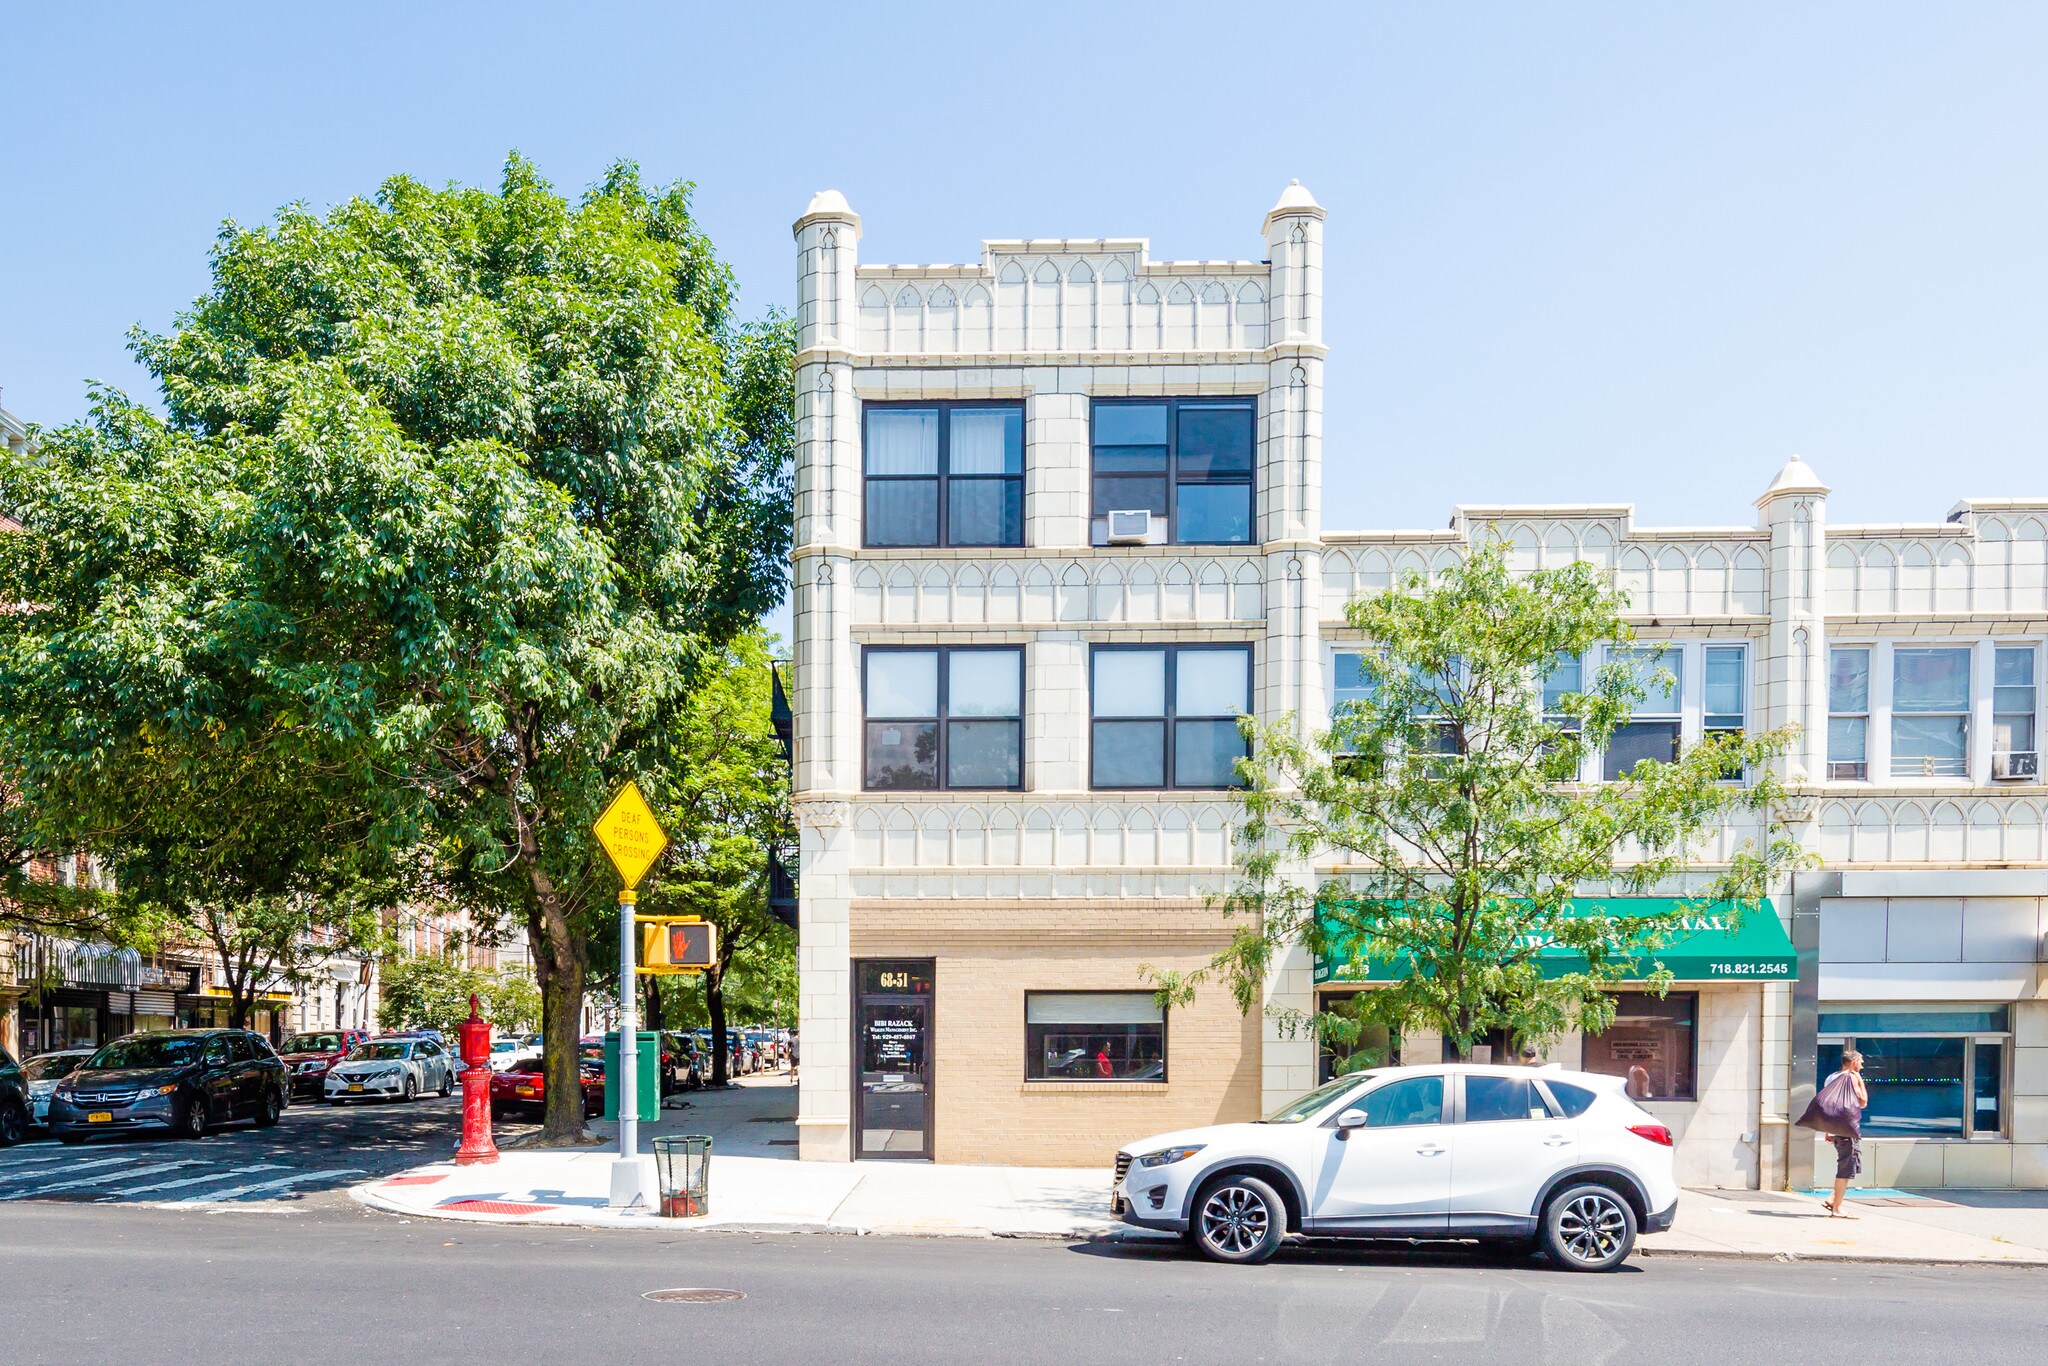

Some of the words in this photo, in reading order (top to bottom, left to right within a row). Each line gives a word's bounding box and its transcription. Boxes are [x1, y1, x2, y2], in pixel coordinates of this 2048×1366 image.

[621, 811, 641, 825] DEAF
[613, 827, 648, 843] PERSONS
[613, 844, 650, 860] CROSSING
[1709, 963, 1788, 974] 718.821.2545
[880, 972, 908, 988] 68-51
